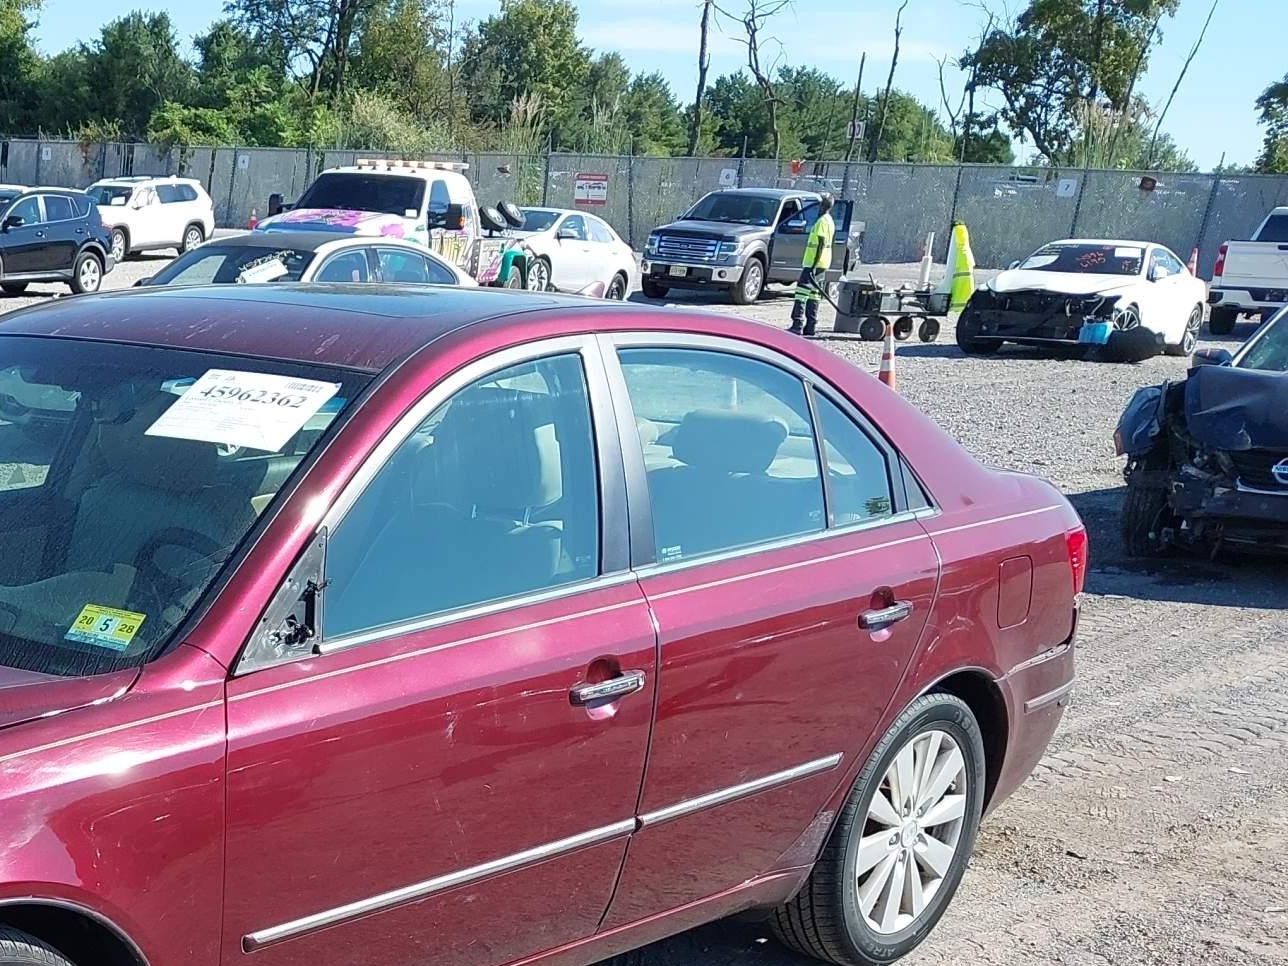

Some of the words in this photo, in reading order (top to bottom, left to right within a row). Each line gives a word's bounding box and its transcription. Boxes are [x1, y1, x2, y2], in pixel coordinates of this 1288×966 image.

[200, 384, 309, 409] 45962362
[79, 615, 95, 626] 20
[99, 618, 113, 632] 5
[118, 623, 135, 634] 28
